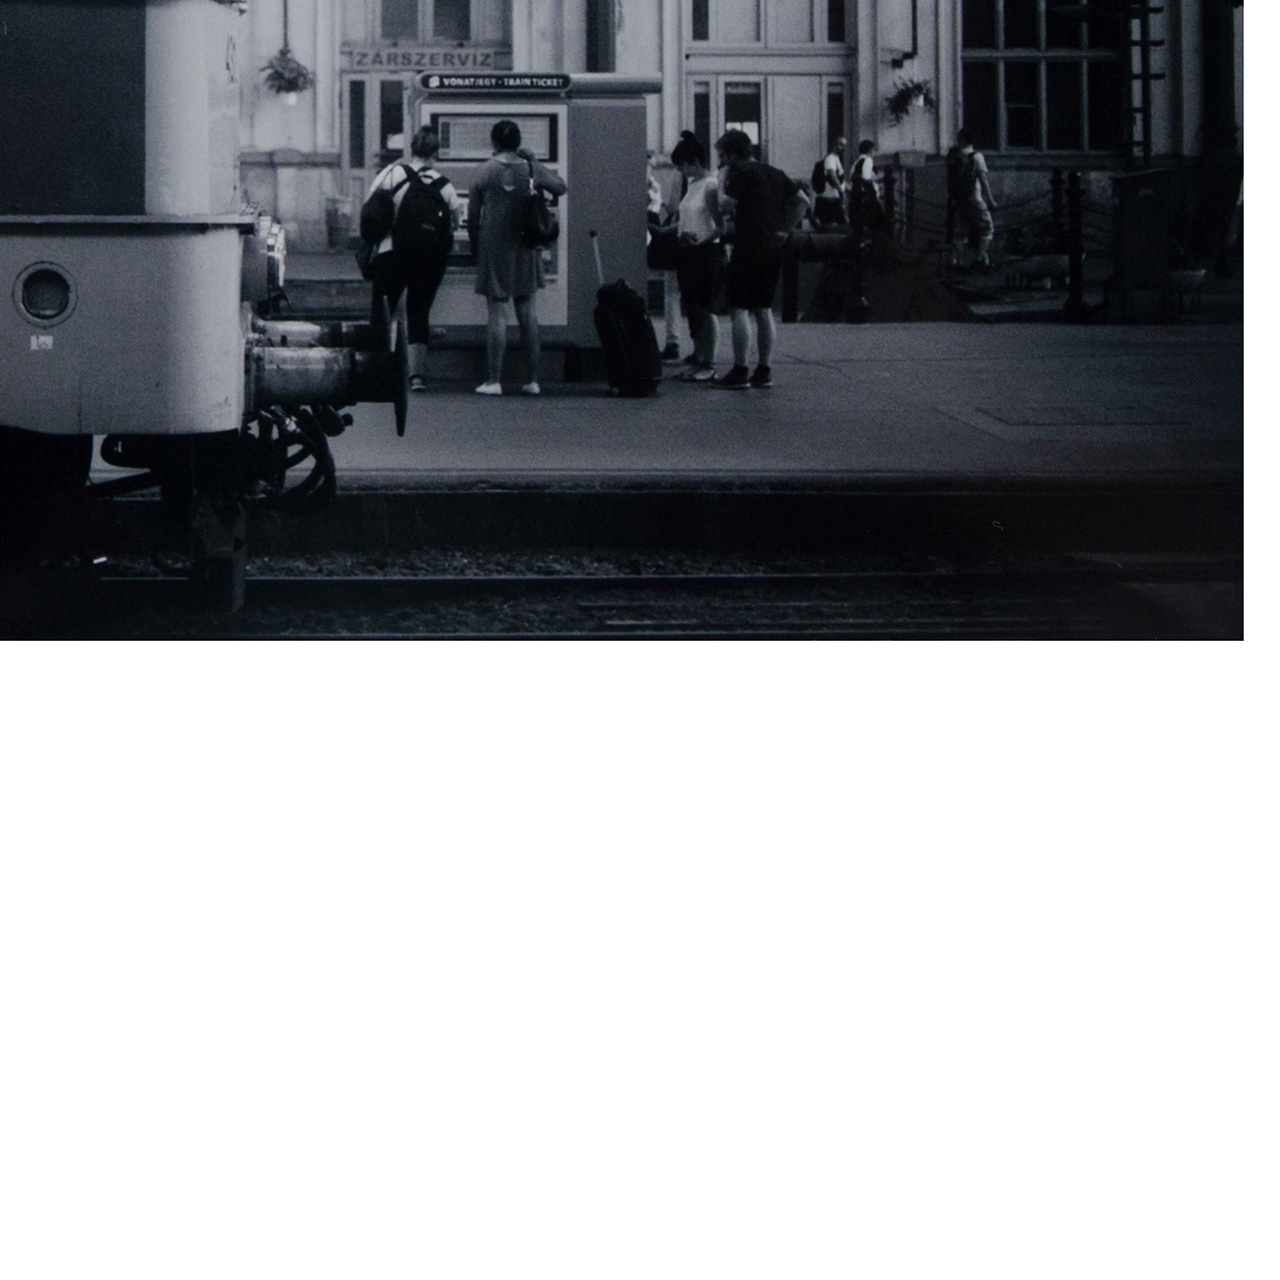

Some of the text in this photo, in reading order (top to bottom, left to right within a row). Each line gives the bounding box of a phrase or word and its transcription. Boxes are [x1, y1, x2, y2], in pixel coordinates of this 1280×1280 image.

[443, 77, 565, 87] VONATJEGY TRAIN TICKET
